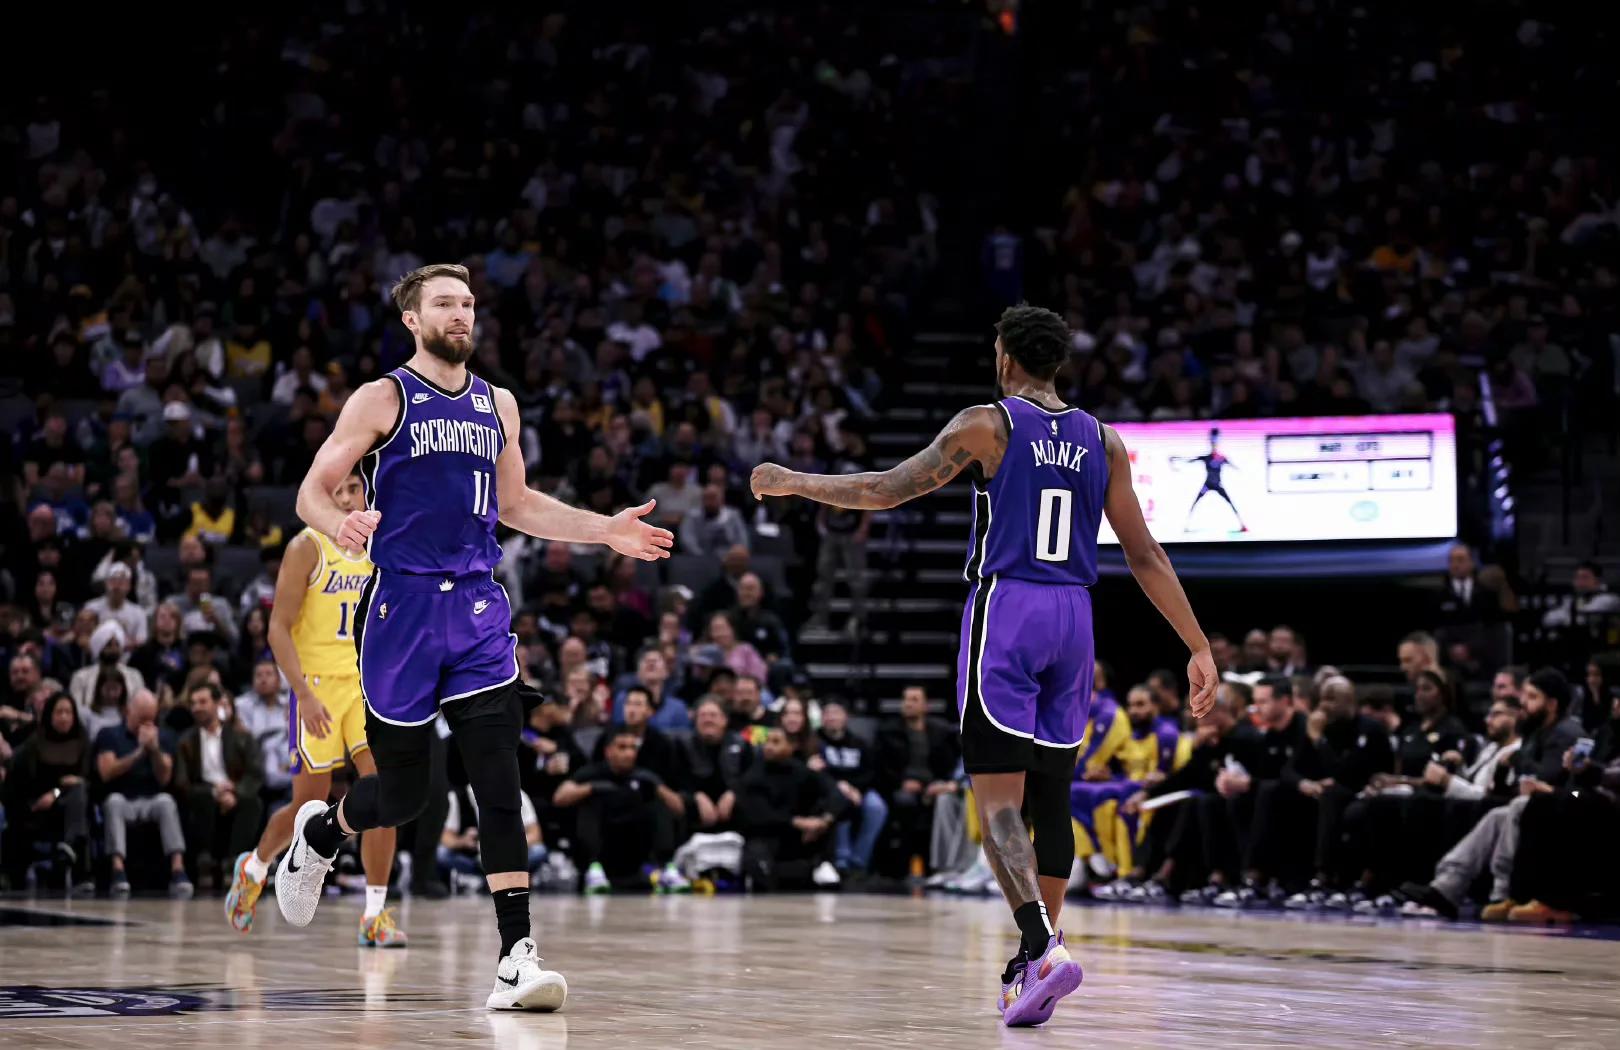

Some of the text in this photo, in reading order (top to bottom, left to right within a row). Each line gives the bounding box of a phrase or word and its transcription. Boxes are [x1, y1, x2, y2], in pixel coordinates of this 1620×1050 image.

[410, 419, 498, 464] SACRAMENTO
[1031, 440, 1088, 472] MONK
[473, 471, 490, 515] 11
[1036, 488, 1072, 561] 0
